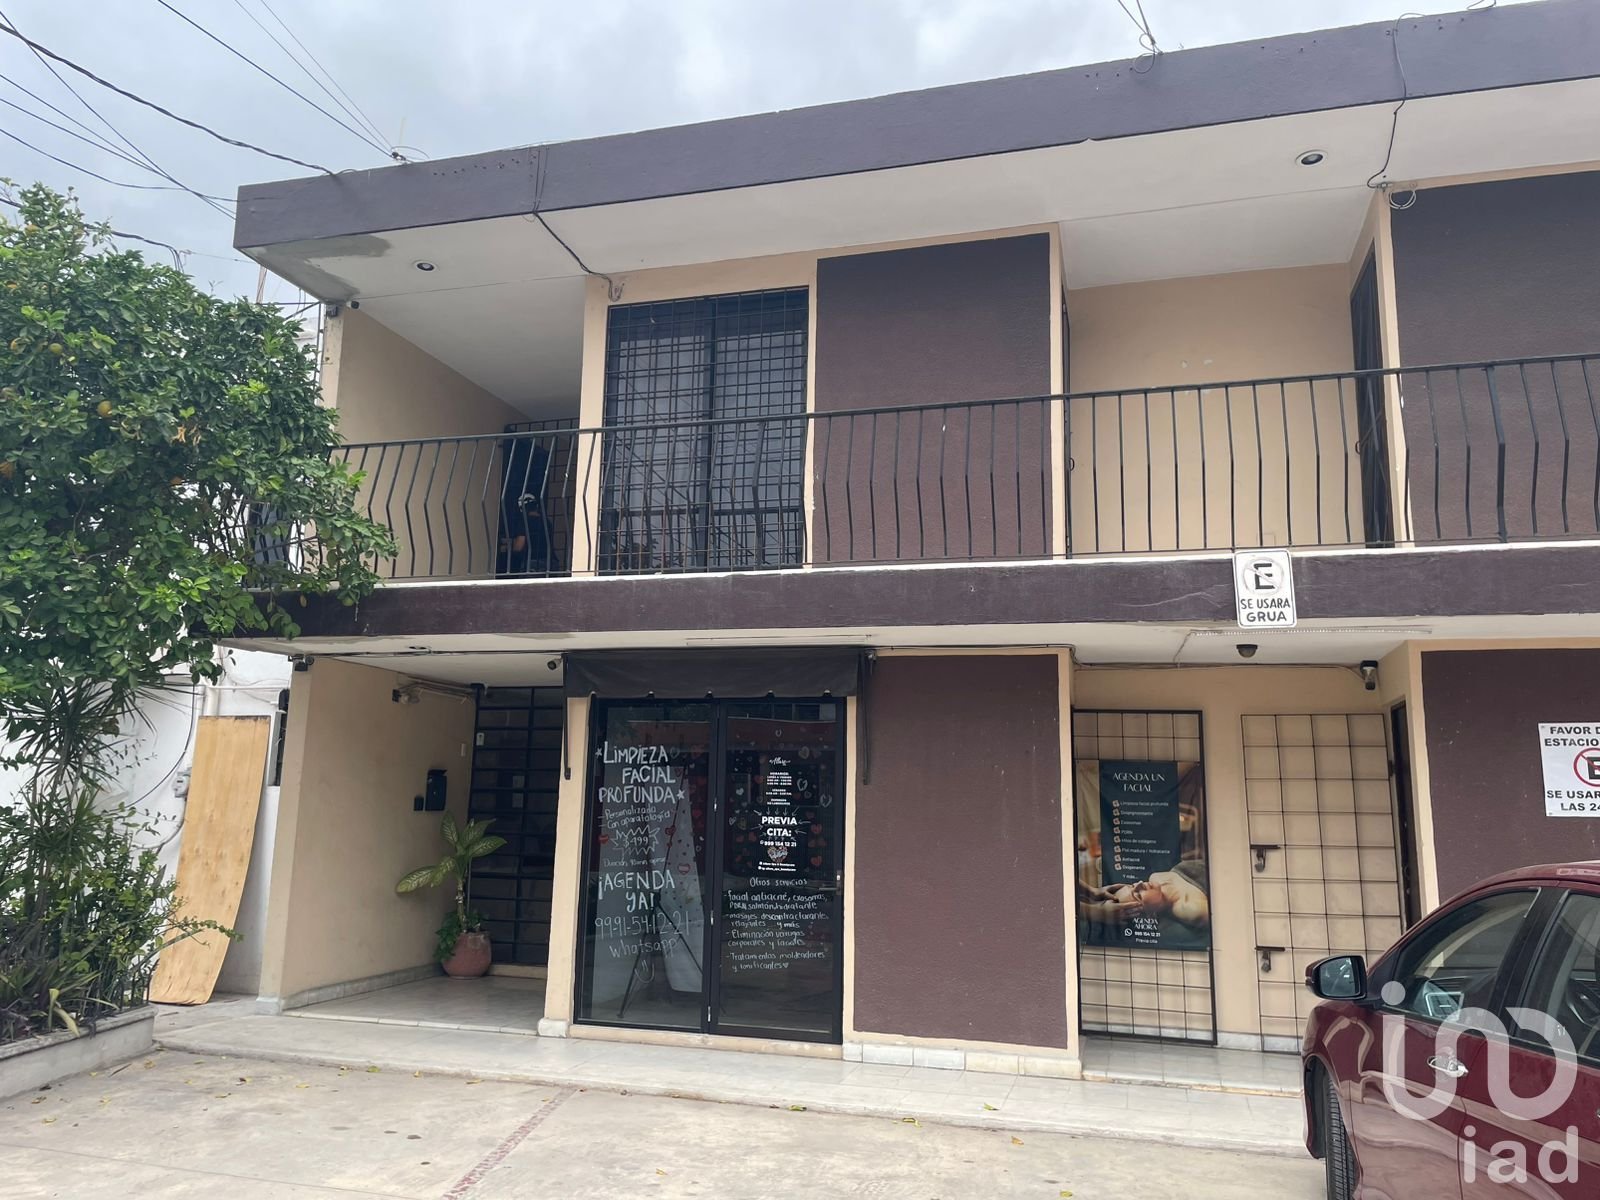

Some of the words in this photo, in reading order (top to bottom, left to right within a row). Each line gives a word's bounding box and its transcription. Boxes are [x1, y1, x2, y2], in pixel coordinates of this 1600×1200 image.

[1240, 598, 1254, 610] SE
[1256, 598, 1291, 609] USARA
[1246, 611, 1287, 622] GRUA
[1550, 726, 1591, 735] FAVOR
[1544, 738, 1599, 747] ESTACIO
[1112, 772, 1150, 782] AGENDA
[1151, 773, 1166, 782] UN
[1124, 783, 1153, 792] FACIAL
[598, 785, 676, 804] PROFUNDA
[1546, 790, 1562, 799] SE
[1560, 802, 1586, 812] LAS
[762, 816, 798, 825] PREVIA
[766, 828, 792, 836] CITA:
[598, 869, 676, 900] ¡AGENDA
[749, 876, 770, 887] Otros
[626, 891, 655, 913] YA!
